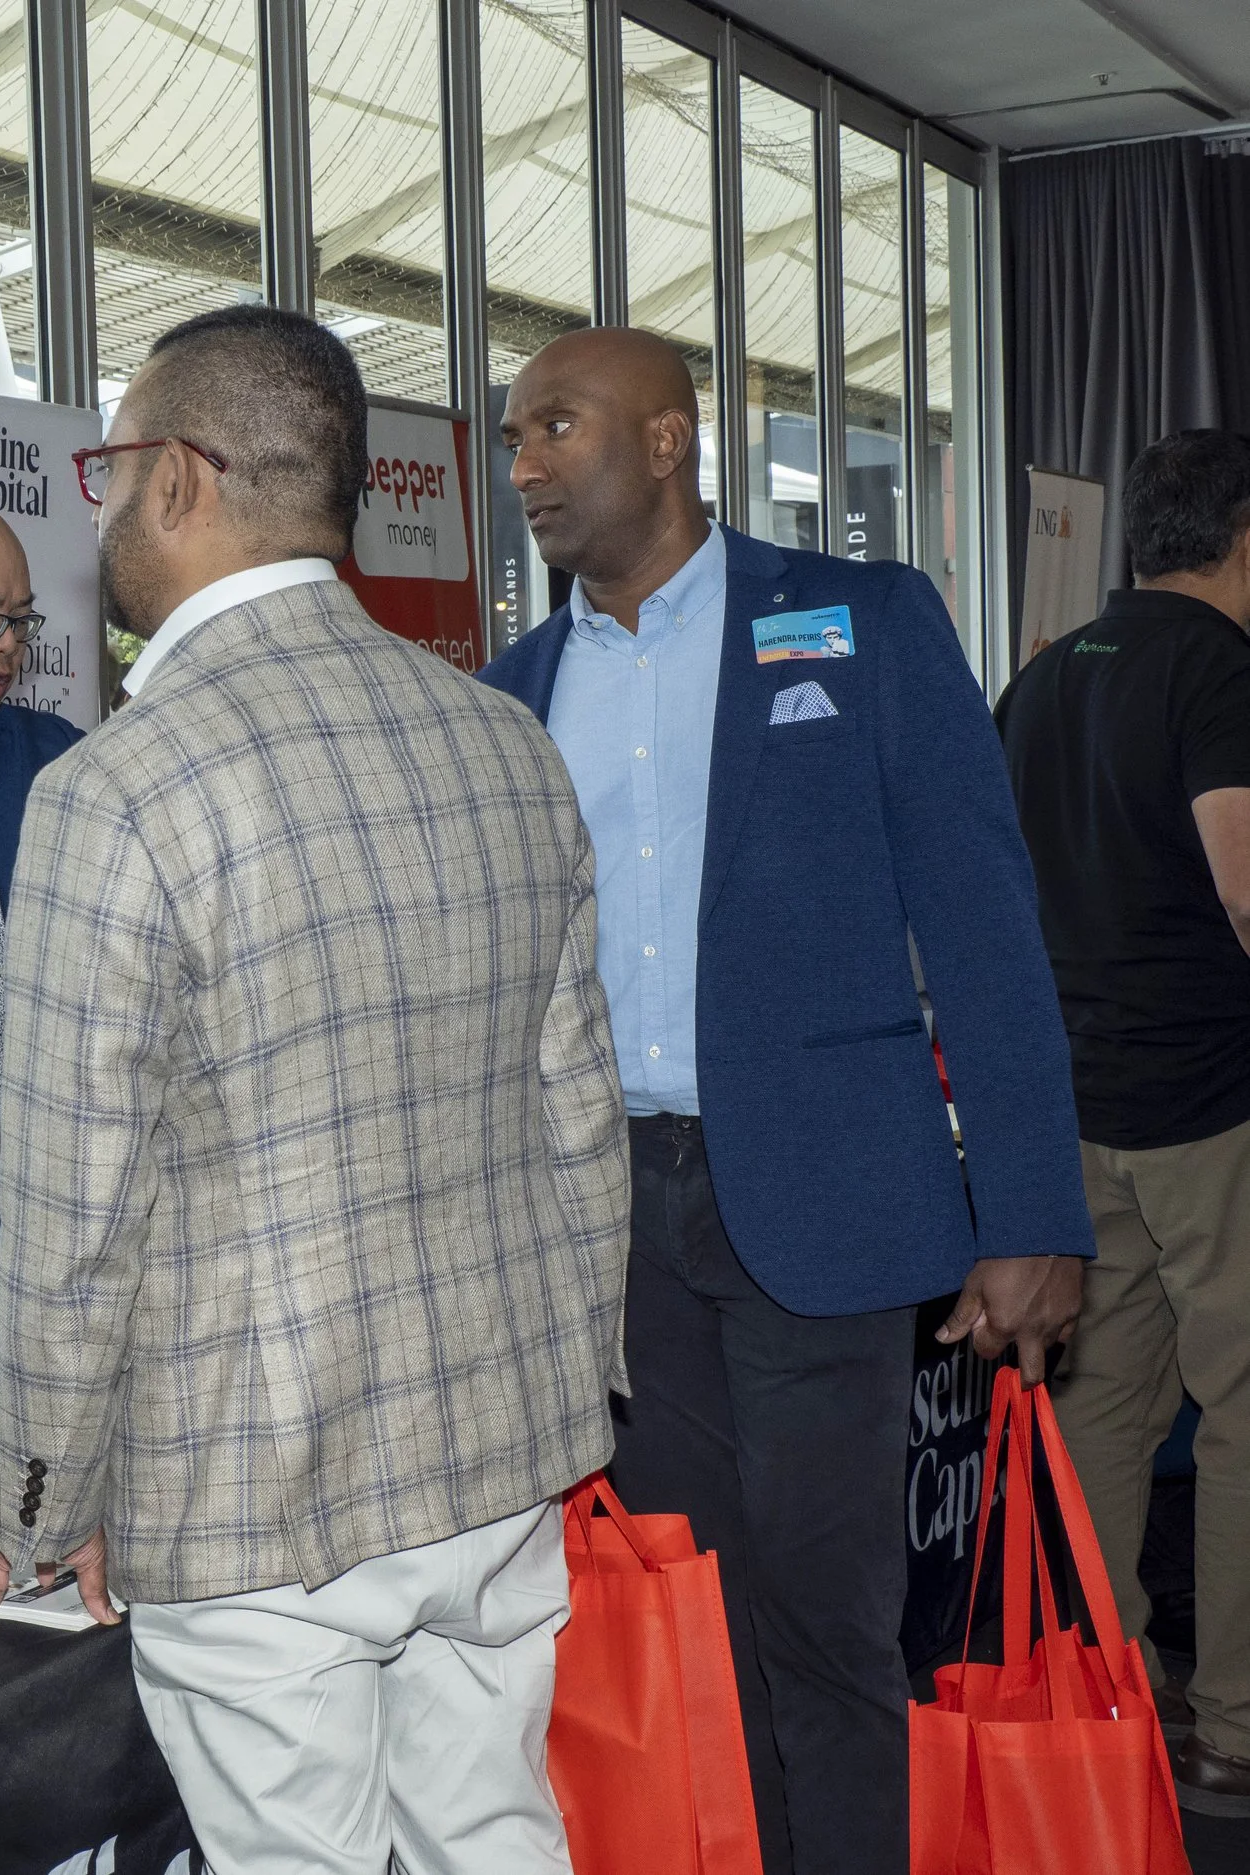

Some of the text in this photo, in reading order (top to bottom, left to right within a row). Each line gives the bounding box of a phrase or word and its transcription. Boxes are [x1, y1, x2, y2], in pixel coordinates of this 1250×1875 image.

[846, 512, 866, 562] ADE
[1035, 508, 1057, 537] ING
[387, 523, 437, 556] money
[505, 558, 517, 645] OCKLANDS
[758, 632, 822, 648] HARENDRA PEIRIS
